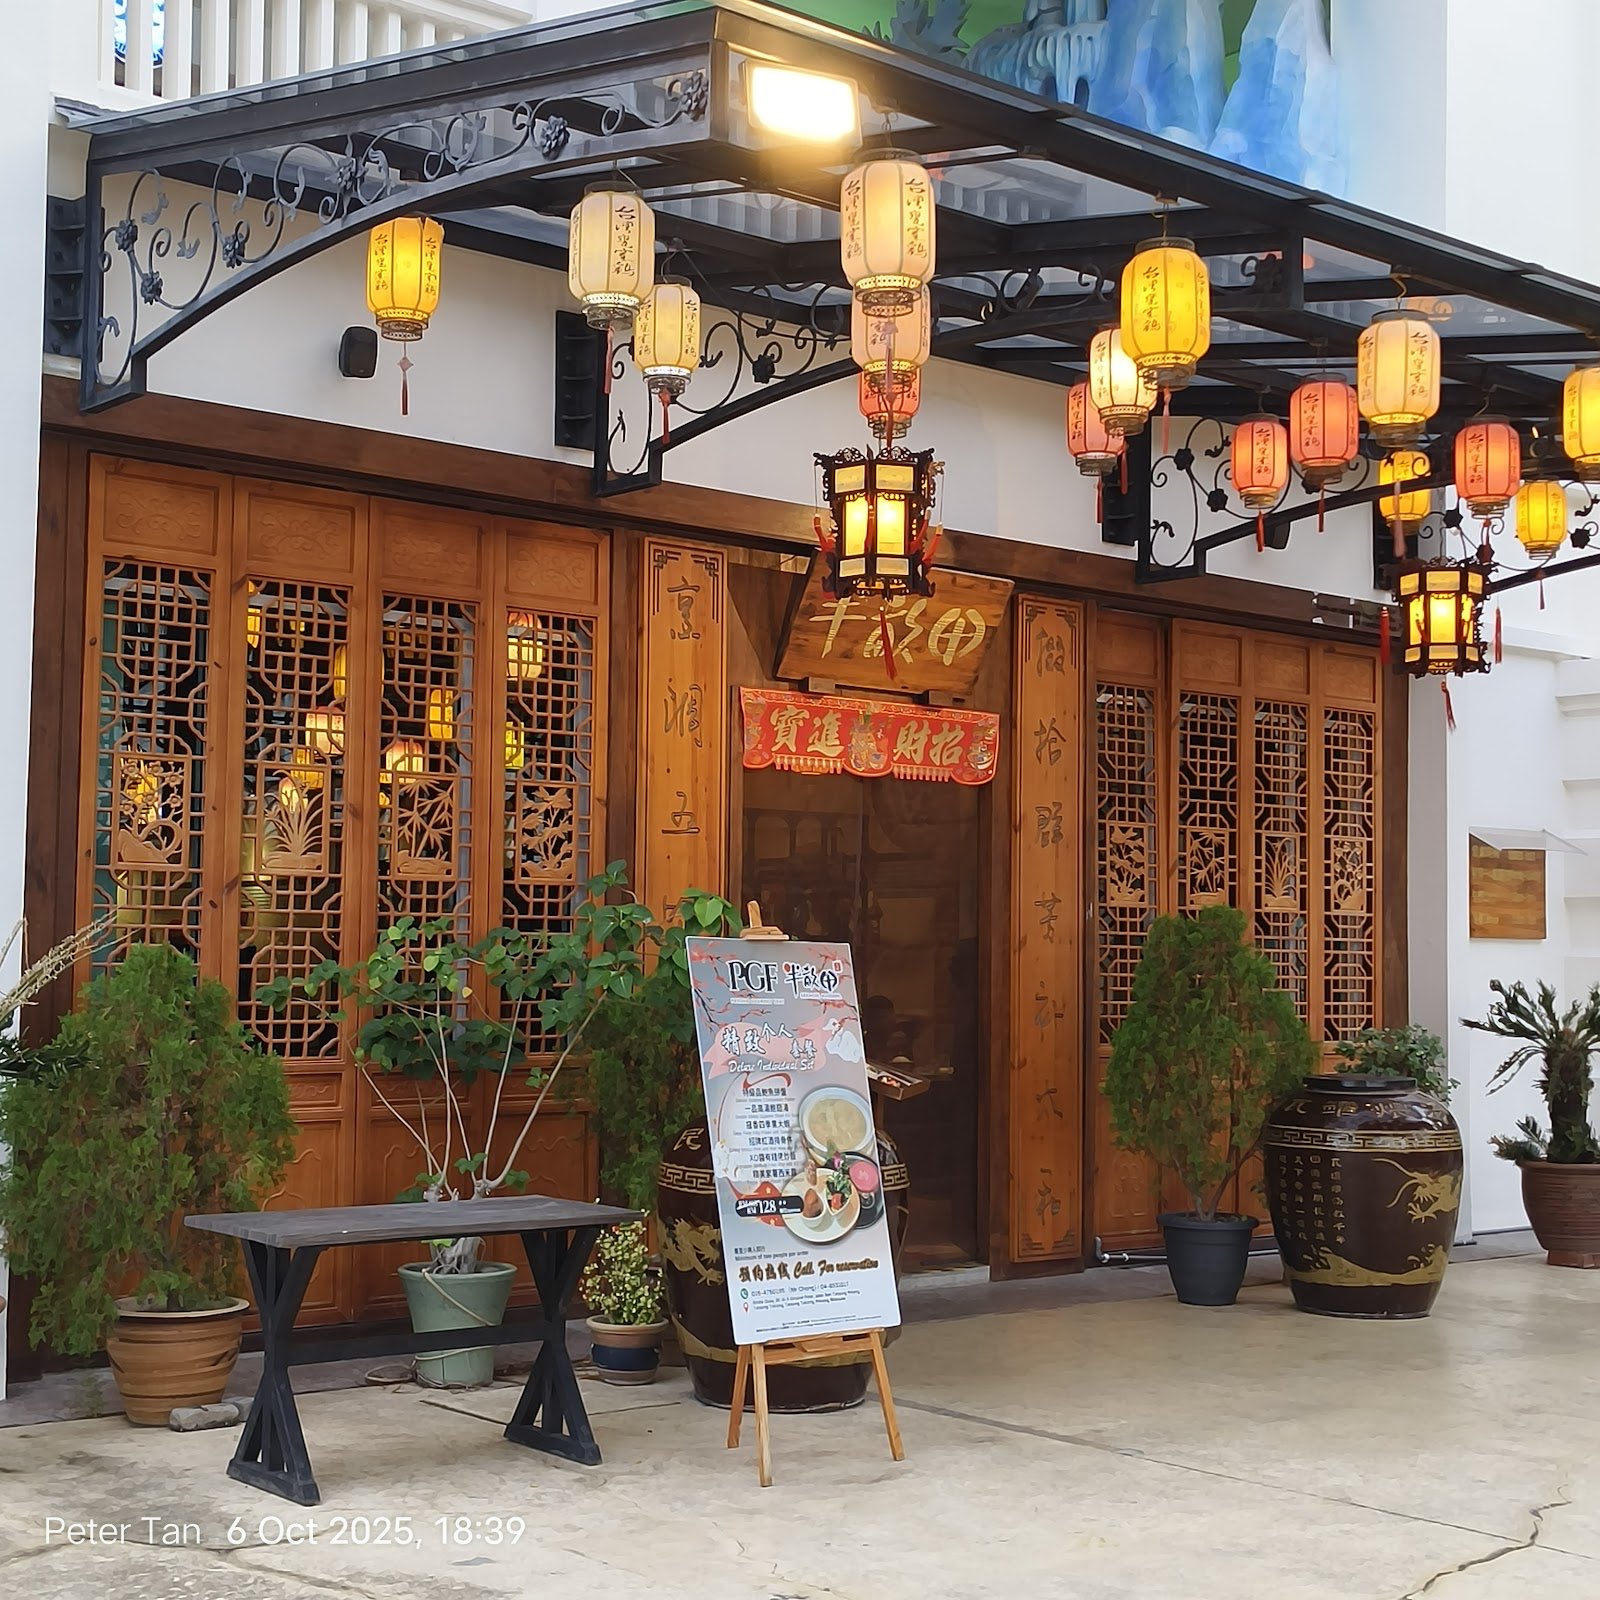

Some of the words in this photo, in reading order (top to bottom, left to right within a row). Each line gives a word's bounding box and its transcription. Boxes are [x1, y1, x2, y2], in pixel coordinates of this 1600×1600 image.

[727, 960, 777, 992] PGF
[760, 1200, 777, 1213] 128
[793, 1260, 815, 1279] Call
[818, 1259, 834, 1276] For
